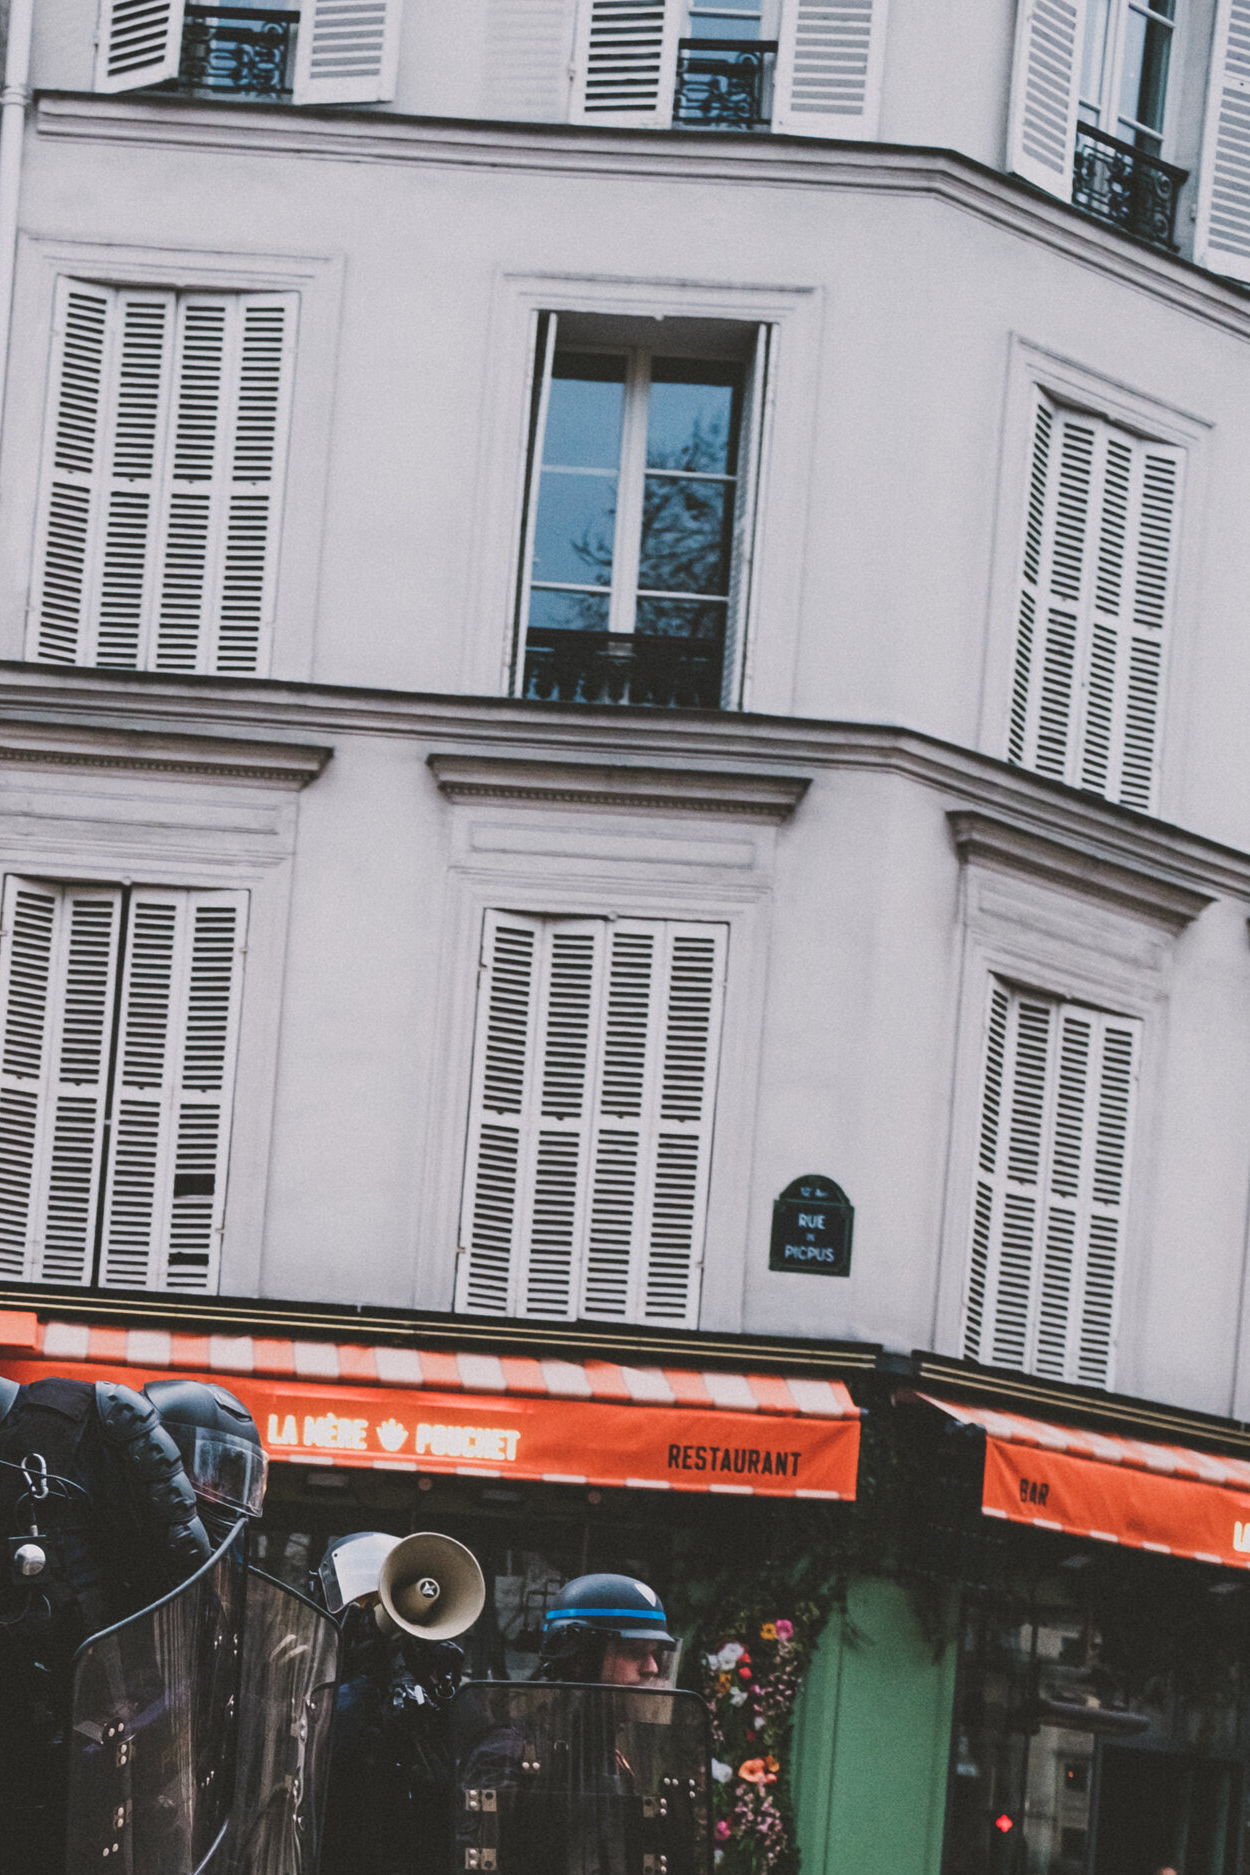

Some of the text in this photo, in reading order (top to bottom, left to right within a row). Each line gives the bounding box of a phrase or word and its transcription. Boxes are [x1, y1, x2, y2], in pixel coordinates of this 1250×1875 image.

[798, 1213, 826, 1229] RUE
[784, 1244, 835, 1262] PICPUS
[267, 1413, 298, 1445] LA
[303, 1412, 368, 1449] MÈRE
[668, 1444, 802, 1477] RESTAURANT
[1020, 1478, 1049, 1506] BAR
